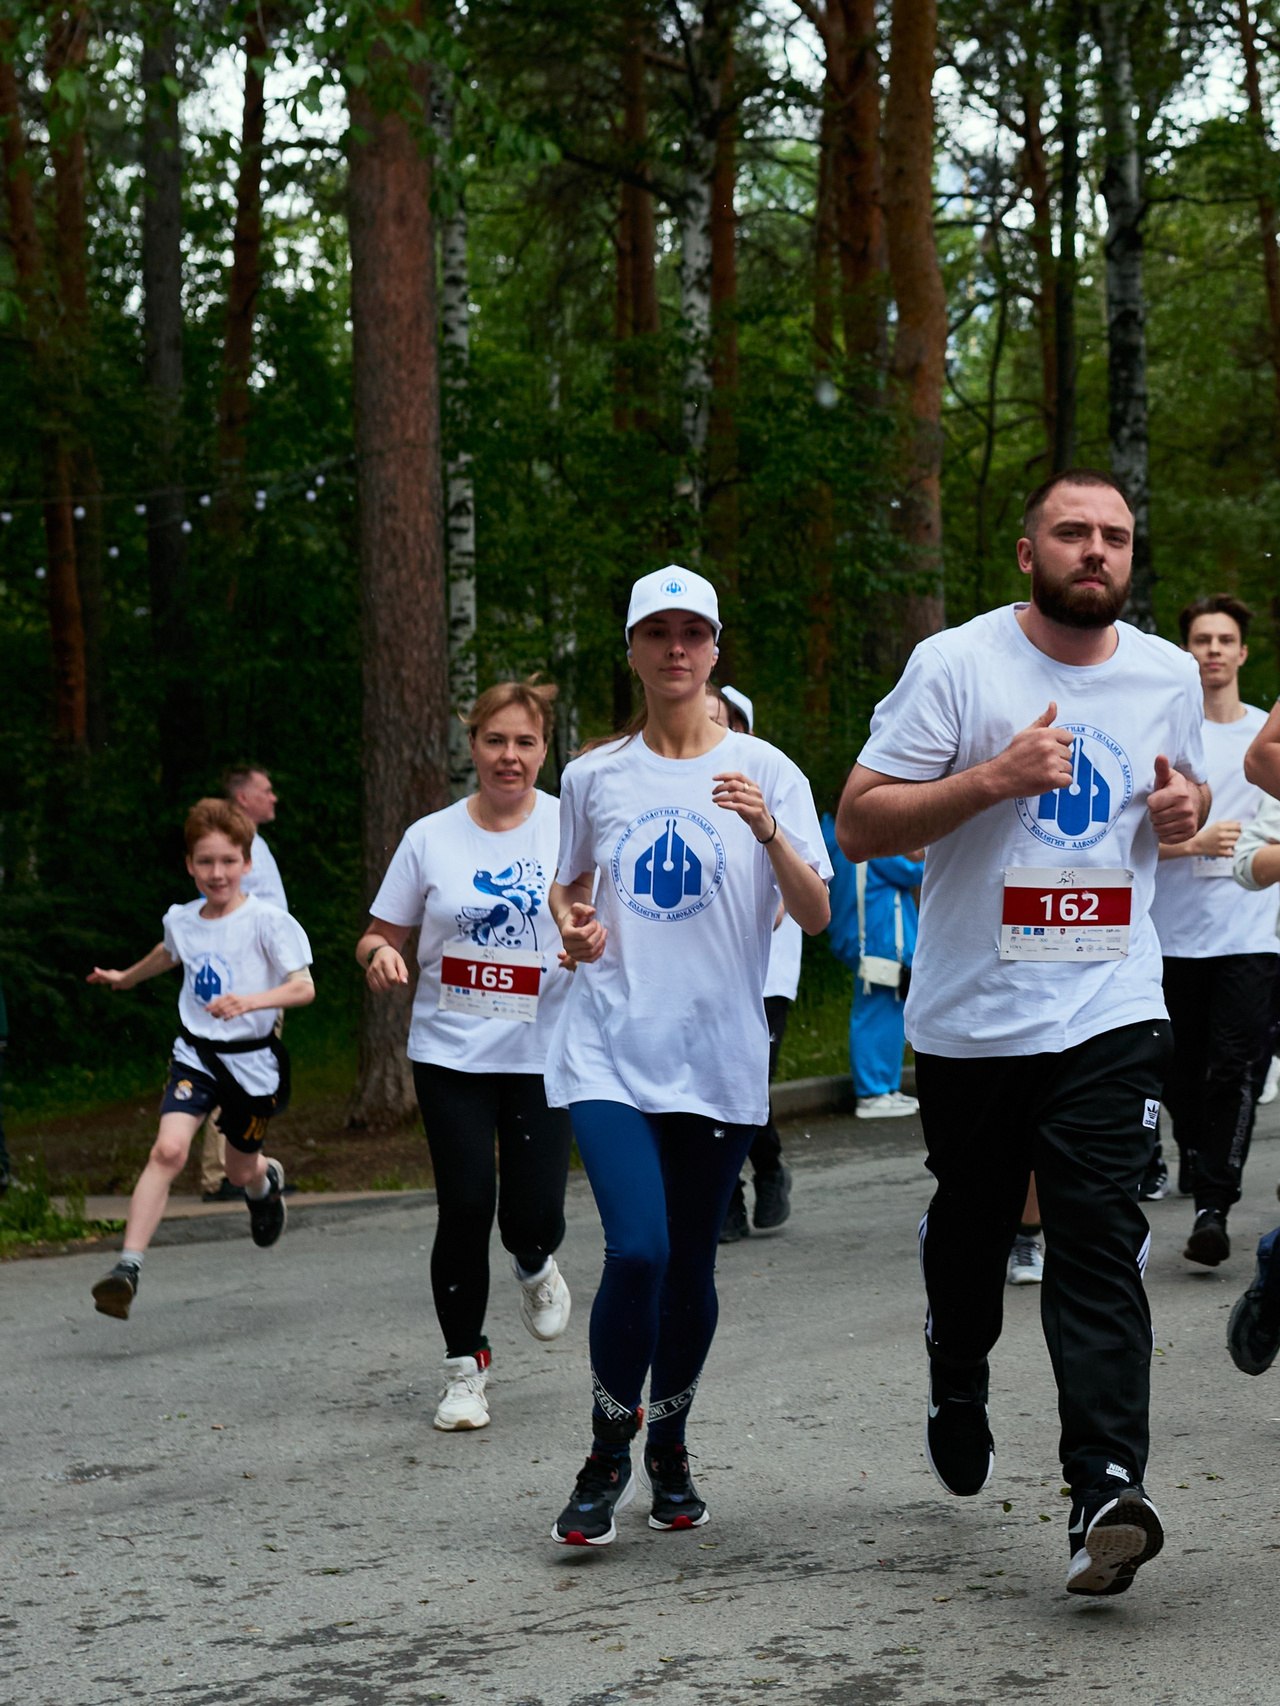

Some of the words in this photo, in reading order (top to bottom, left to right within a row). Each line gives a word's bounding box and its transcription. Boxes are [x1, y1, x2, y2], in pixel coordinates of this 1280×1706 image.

[1040, 893, 1099, 921] 162
[467, 964, 514, 990] 165
[595, 1389, 625, 1419] ZENIT
[1108, 1462, 1128, 1475] NIKE
